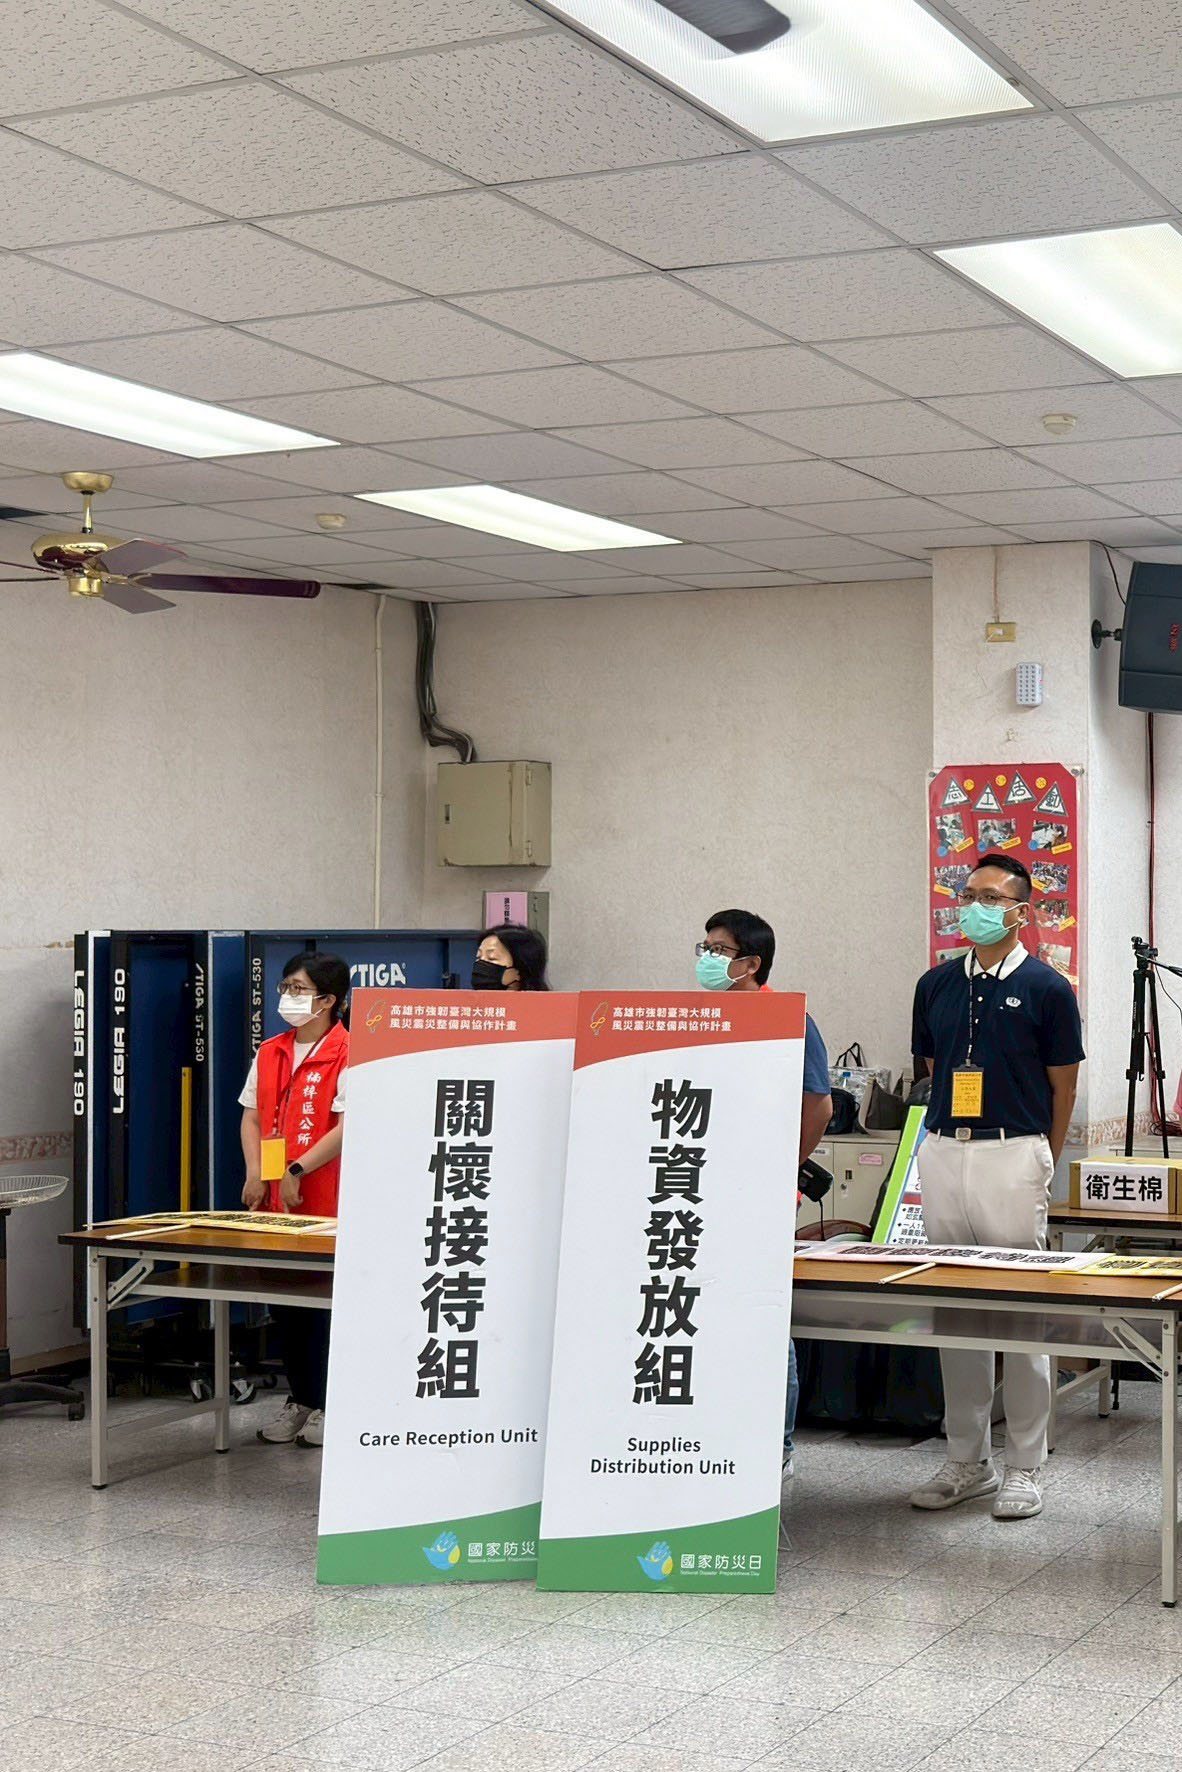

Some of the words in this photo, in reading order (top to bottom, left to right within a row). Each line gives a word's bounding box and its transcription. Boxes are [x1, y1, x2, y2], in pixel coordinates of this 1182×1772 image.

[113, 968, 126, 1016] 190
[252, 957, 262, 1006] ST-530
[74, 970, 85, 1057] LEGIA
[389, 1018, 518, 1032] 風災震災整備與協作計畫
[390, 1005, 507, 1018] 高雄市強韌臺灣大規模
[612, 1020, 732, 1032] 風災震災整備與協作計畫
[613, 1006, 721, 1018] 高雄市強韌臺灣大規模
[195, 1015, 205, 1062] ST-530
[113, 1027, 125, 1114] LEGIA
[74, 1068, 85, 1116] 190
[297, 1071, 322, 1147] 楠梓區公所
[1085, 1173, 1164, 1203] 衛生棉
[415, 1079, 495, 1400] 關懷接待組
[631, 1078, 713, 1406] 物資發放組
[359, 1429, 401, 1447] Care
[406, 1428, 496, 1448] Reception
[500, 1427, 538, 1444] Unit
[627, 1436, 702, 1456] Supplies
[590, 1458, 694, 1476] Distribution
[699, 1458, 736, 1476] Unit
[680, 1554, 762, 1570] 國家防災日
